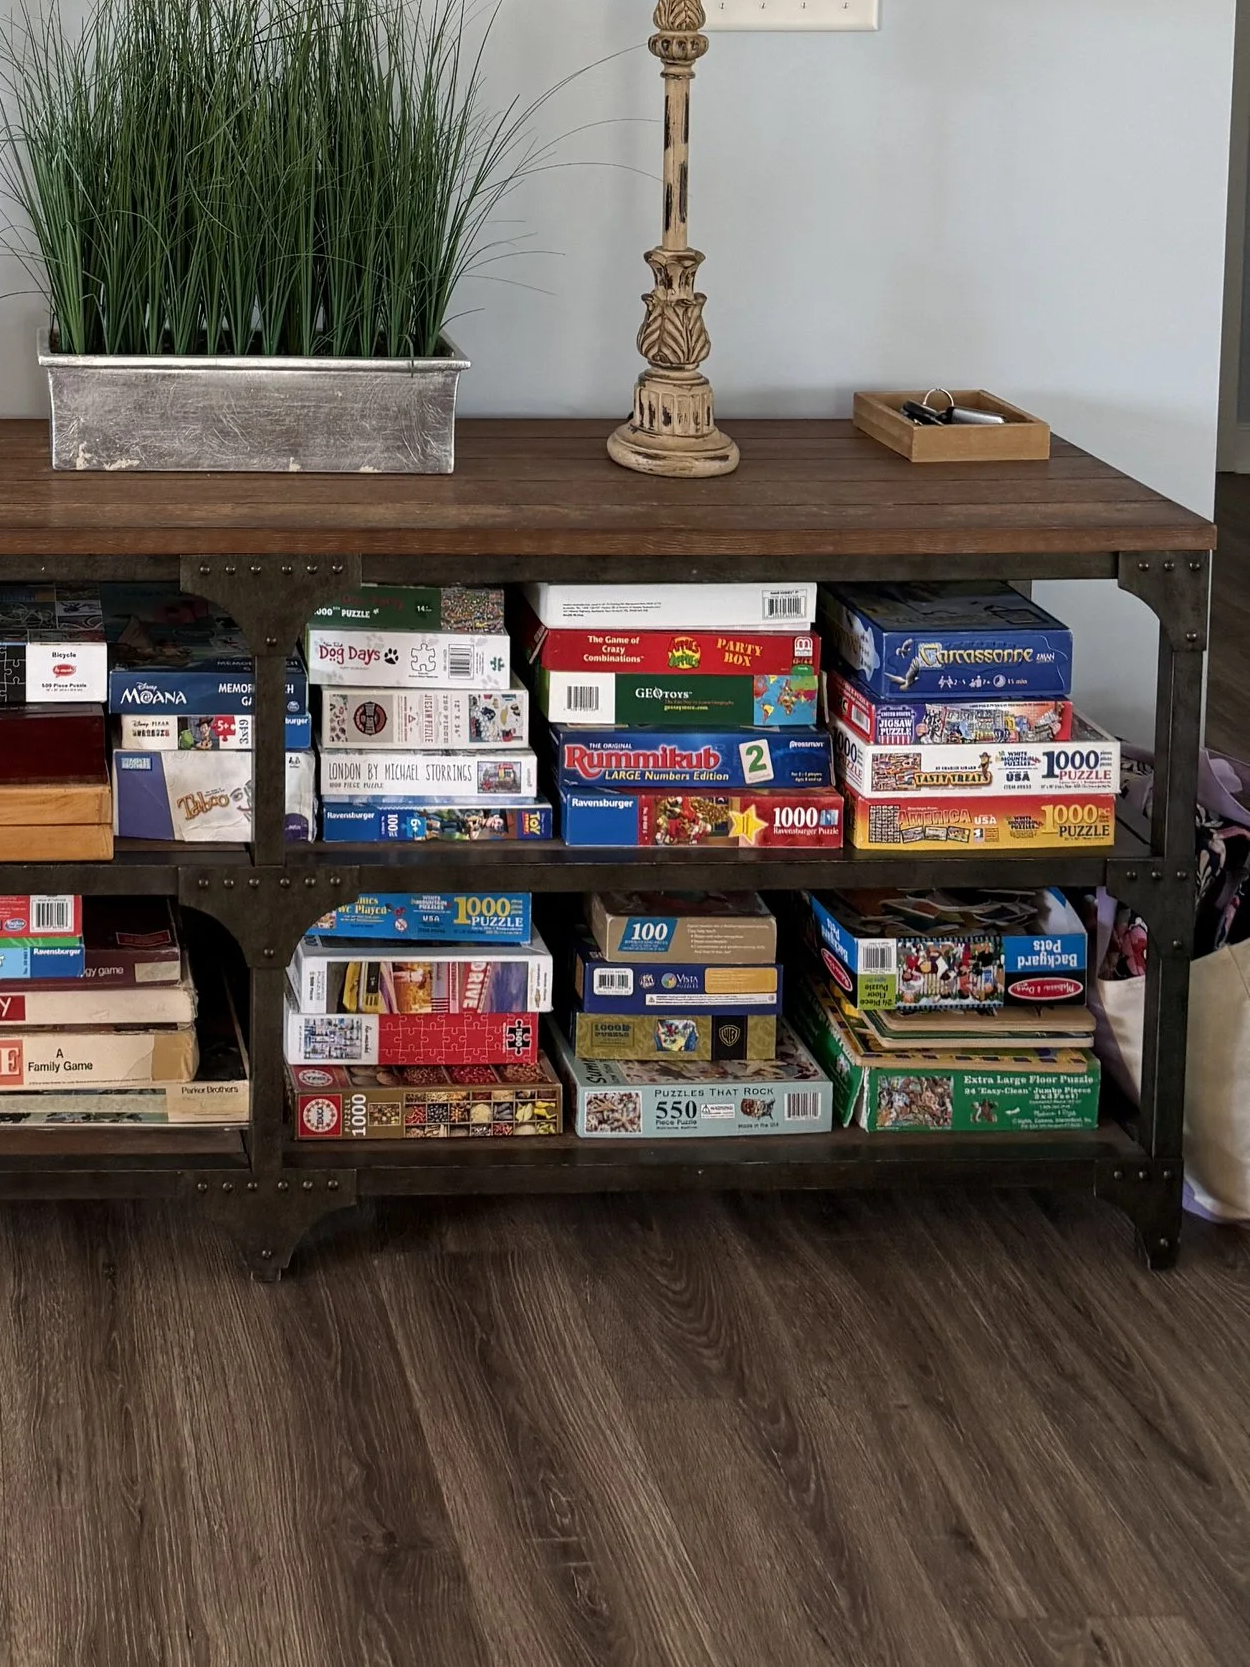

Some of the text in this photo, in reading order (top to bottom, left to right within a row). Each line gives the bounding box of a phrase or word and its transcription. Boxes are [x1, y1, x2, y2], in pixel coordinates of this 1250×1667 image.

[341, 609, 370, 619] PUZZLE
[587, 635, 640, 644] The Game of
[602, 645, 625, 654] Crazy
[716, 638, 763, 657] PARTY
[319, 645, 381, 665] Dog Days
[583, 654, 641, 663] Combinations
[724, 652, 753, 667] BOX
[919, 644, 1034, 667] Carcassonne
[121, 687, 187, 706] MOANA
[217, 720, 230, 731] 5+
[879, 719, 912, 728] JIGSAW
[239, 719, 249, 744] 3x49
[880, 728, 912, 736] PUZZLE
[565, 744, 720, 778] Rummikub
[745, 744, 767, 773] 2
[1042, 750, 1099, 778] 1000
[328, 762, 473, 782] LONDON BY MICHAEL STORRINGS
[605, 770, 729, 781] LARGE Numbers Edition
[915, 772, 990, 785] TASTY TREATS
[1006, 773, 1030, 782] USA
[1059, 769, 1112, 781] PUZZLE
[571, 798, 634, 808] Ravensburger
[327, 811, 375, 820] Ravensburger
[387, 814, 398, 830] 100
[773, 807, 818, 828] 1000
[899, 809, 973, 826] AMERICA
[974, 816, 997, 824] USA
[1041, 804, 1099, 834] 1000
[410, 818, 421, 832] 6+
[529, 811, 541, 835] TOY
[773, 827, 839, 837] Ravensburger Puzzle
[1059, 825, 1110, 837] PUZZLE
[354, 903, 387, 916] Played
[453, 896, 511, 925] 1000
[471, 916, 524, 928] PUZZLE
[631, 923, 668, 941] 100
[1033, 938, 1063, 952] Pets
[33, 948, 81, 956] Ravensburger
[1017, 950, 1078, 969] Backyard
[99, 966, 124, 975] game
[56, 1048, 64, 1059] A
[28, 1060, 93, 1073] Family Game
[964, 1075, 1094, 1086] Extra Large Floor Puzzle
[181, 1085, 239, 1094] Parker Brothers
[654, 1087, 774, 1098] PUZZLES THAT ROCK
[352, 1094, 366, 1136] 1000
[656, 1100, 697, 1119] 550
